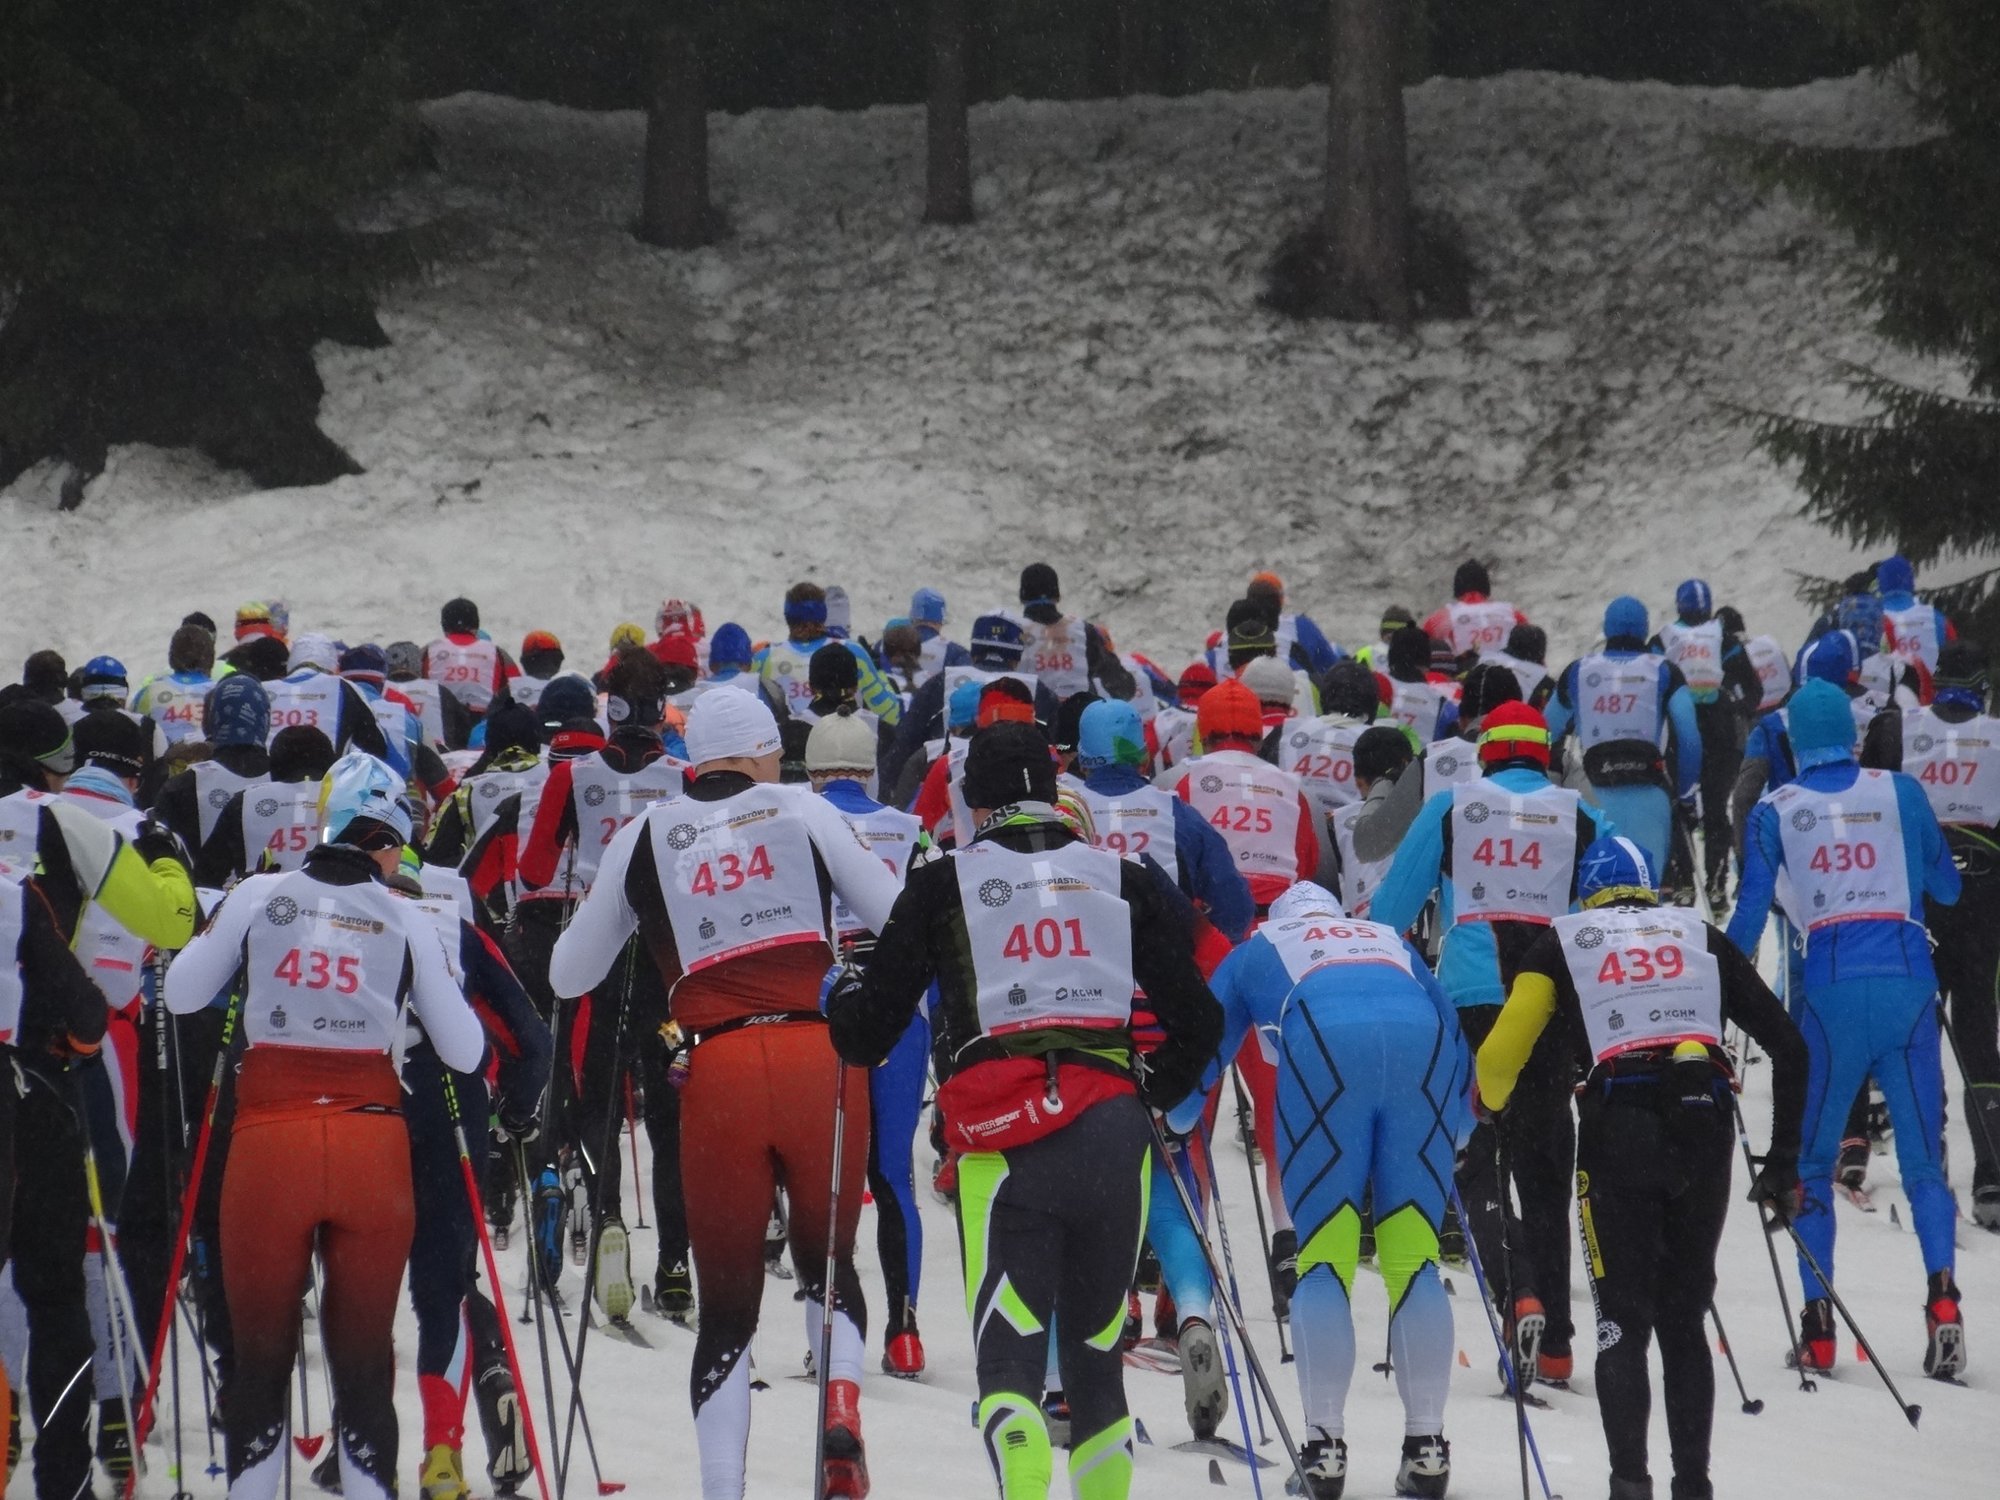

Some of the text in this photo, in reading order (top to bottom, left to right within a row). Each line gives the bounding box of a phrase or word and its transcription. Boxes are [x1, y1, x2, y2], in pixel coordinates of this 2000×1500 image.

[1034, 653, 1073, 671] 348
[444, 665, 481, 682] 291
[162, 703, 205, 723] 443
[1594, 694, 1638, 714] 487
[271, 709, 319, 727] 303
[1293, 754, 1352, 783] 420
[1920, 761, 1978, 786] 407
[1210, 805, 1273, 834] 425
[1472, 838, 1543, 870] 414
[1809, 842, 1876, 875] 430
[690, 844, 775, 897] 434
[756, 905, 793, 920] KGHM
[1002, 918, 1092, 963] 401
[1302, 926, 1378, 942] 465
[273, 948, 361, 994] 435
[1597, 945, 1684, 986] 439
[1071, 988, 1103, 999] KGHM
[1664, 1008, 1697, 1019] KGHM
[330, 1019, 366, 1030] KGHM
